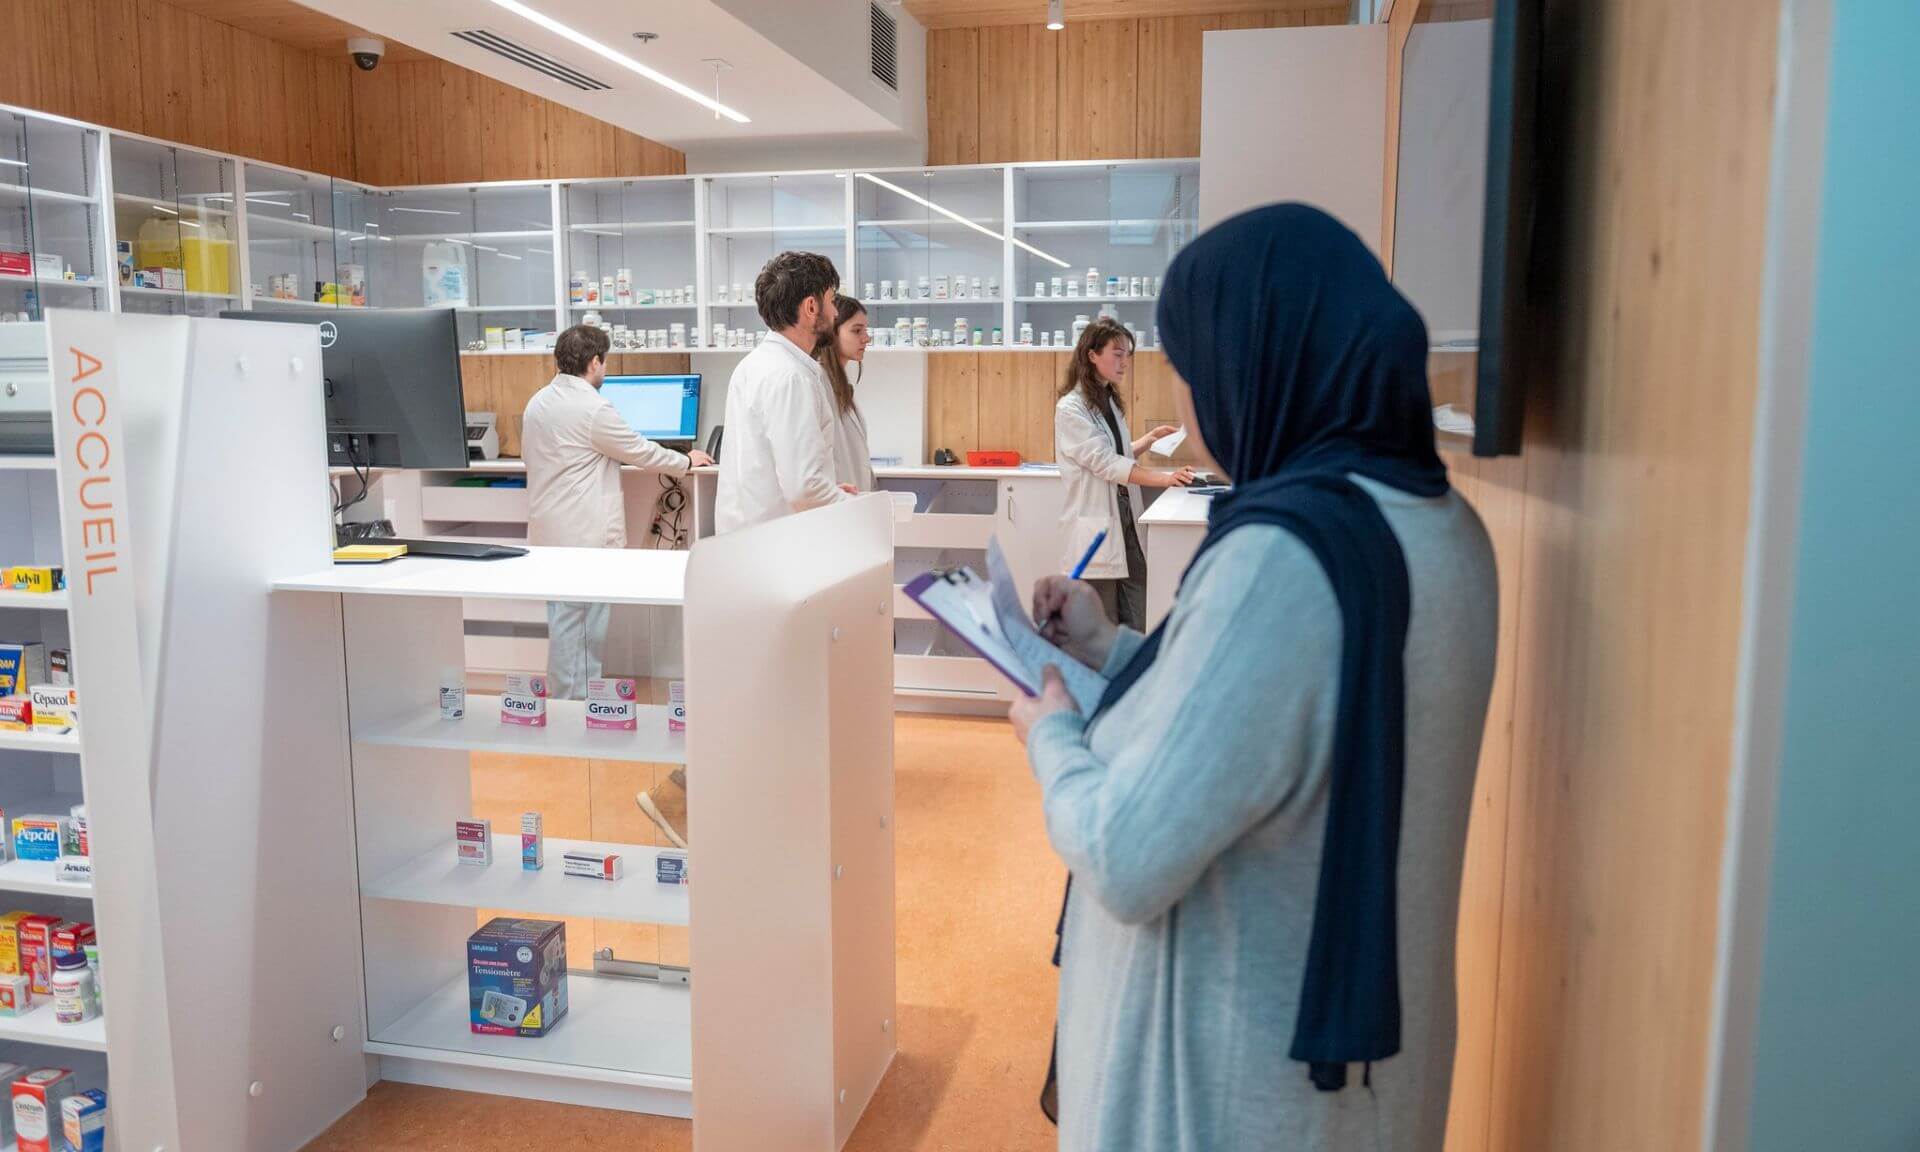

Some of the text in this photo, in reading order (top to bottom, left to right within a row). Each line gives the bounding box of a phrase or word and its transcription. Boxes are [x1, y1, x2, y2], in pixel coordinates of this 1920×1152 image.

[69, 346, 118, 595] ACCUEIL
[15, 571, 40, 586] Advil
[504, 697, 537, 711] Gravol
[588, 703, 628, 715] Gravol
[17, 828, 55, 842] Pepcid
[472, 965, 521, 977] Tensiomètre
